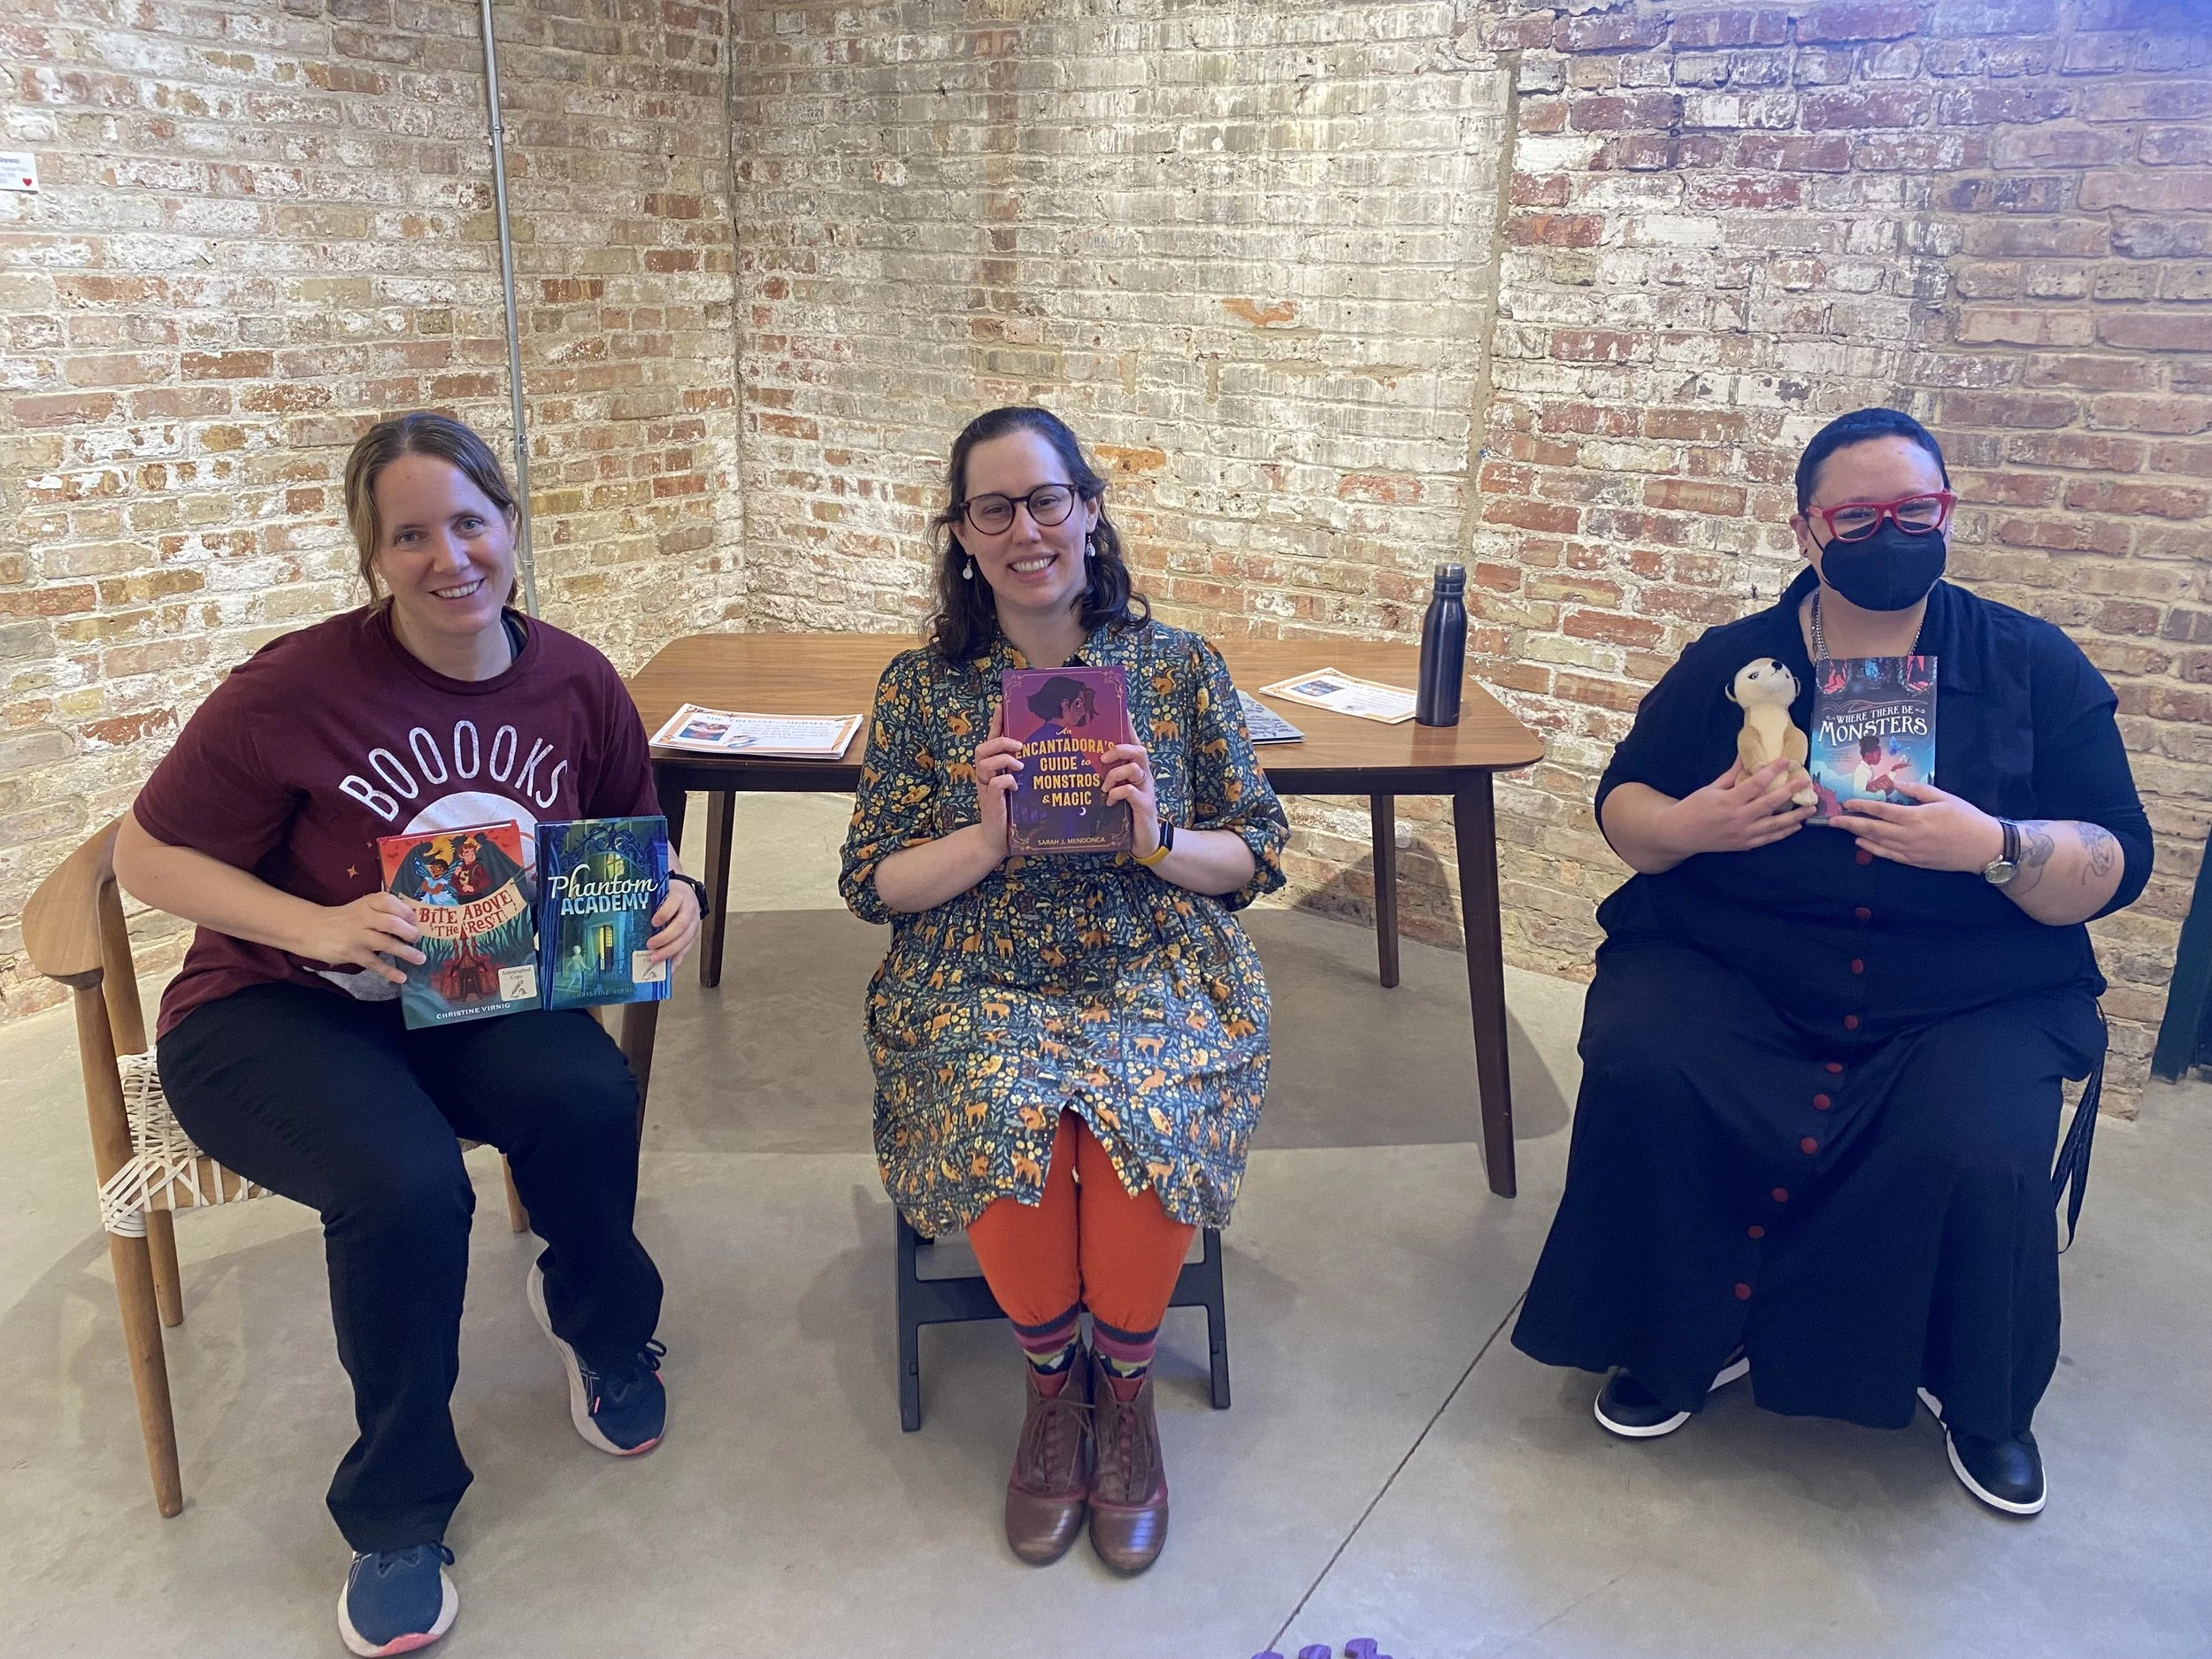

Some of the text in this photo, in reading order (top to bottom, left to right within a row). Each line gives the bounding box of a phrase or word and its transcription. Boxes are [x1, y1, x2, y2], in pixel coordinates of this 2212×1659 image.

[1835, 705, 1915, 725] WHERE THERE BE
[1056, 726, 1072, 735] An
[1817, 716, 1928, 747] MONSTERS
[1040, 757, 1077, 772] GUIDE
[1033, 773, 1101, 790] MONSTROS
[1041, 791, 1092, 807] & MAGIC
[548, 864, 658, 899] Phantom
[463, 889, 514, 920] ABOVE
[560, 892, 649, 916] ACADEMY
[436, 1002, 511, 1019] CHRISTINE VIRNIG
